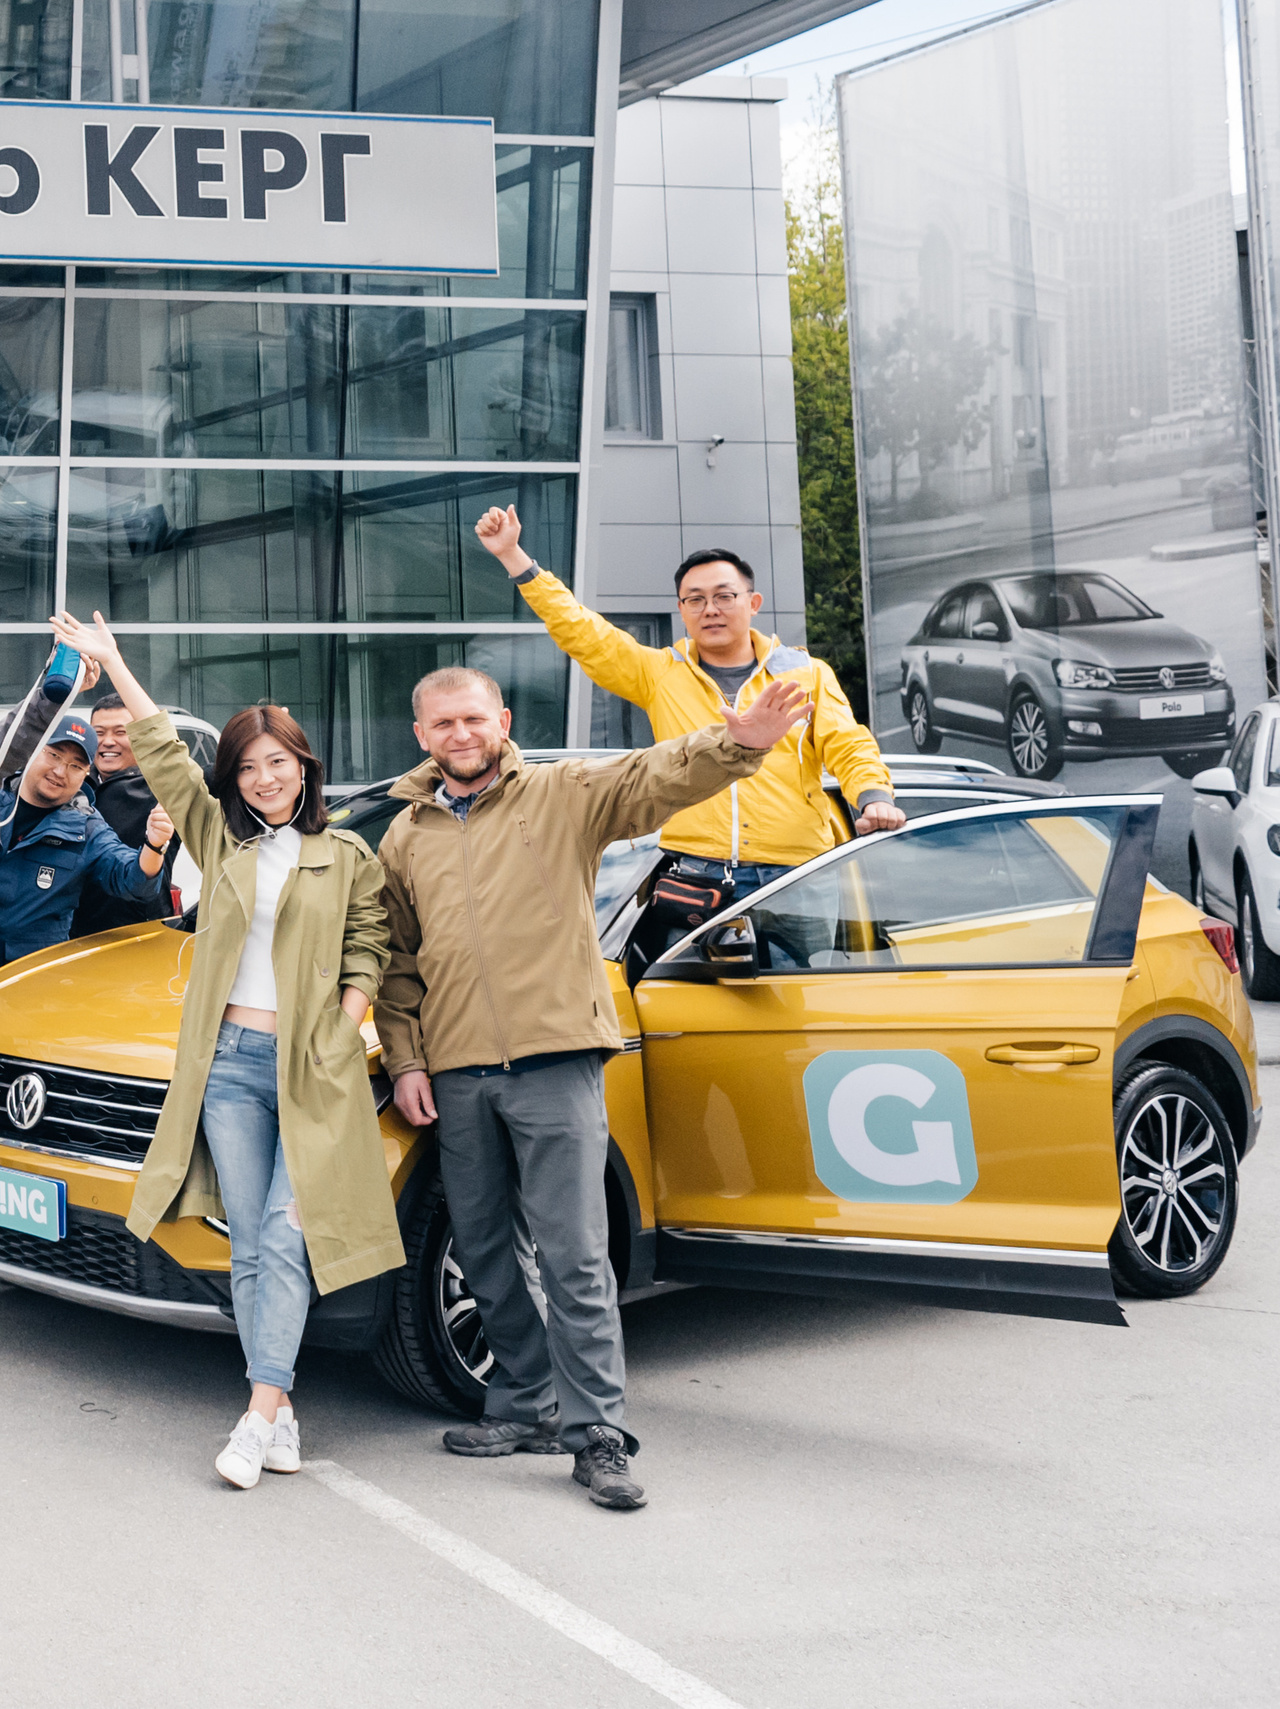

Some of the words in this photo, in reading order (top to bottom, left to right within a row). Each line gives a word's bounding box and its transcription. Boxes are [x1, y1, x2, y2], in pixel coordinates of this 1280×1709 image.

[83, 122, 372, 224] КЕРГ
[1162, 702, 1182, 712] Polo
[827, 1062, 962, 1187] G
